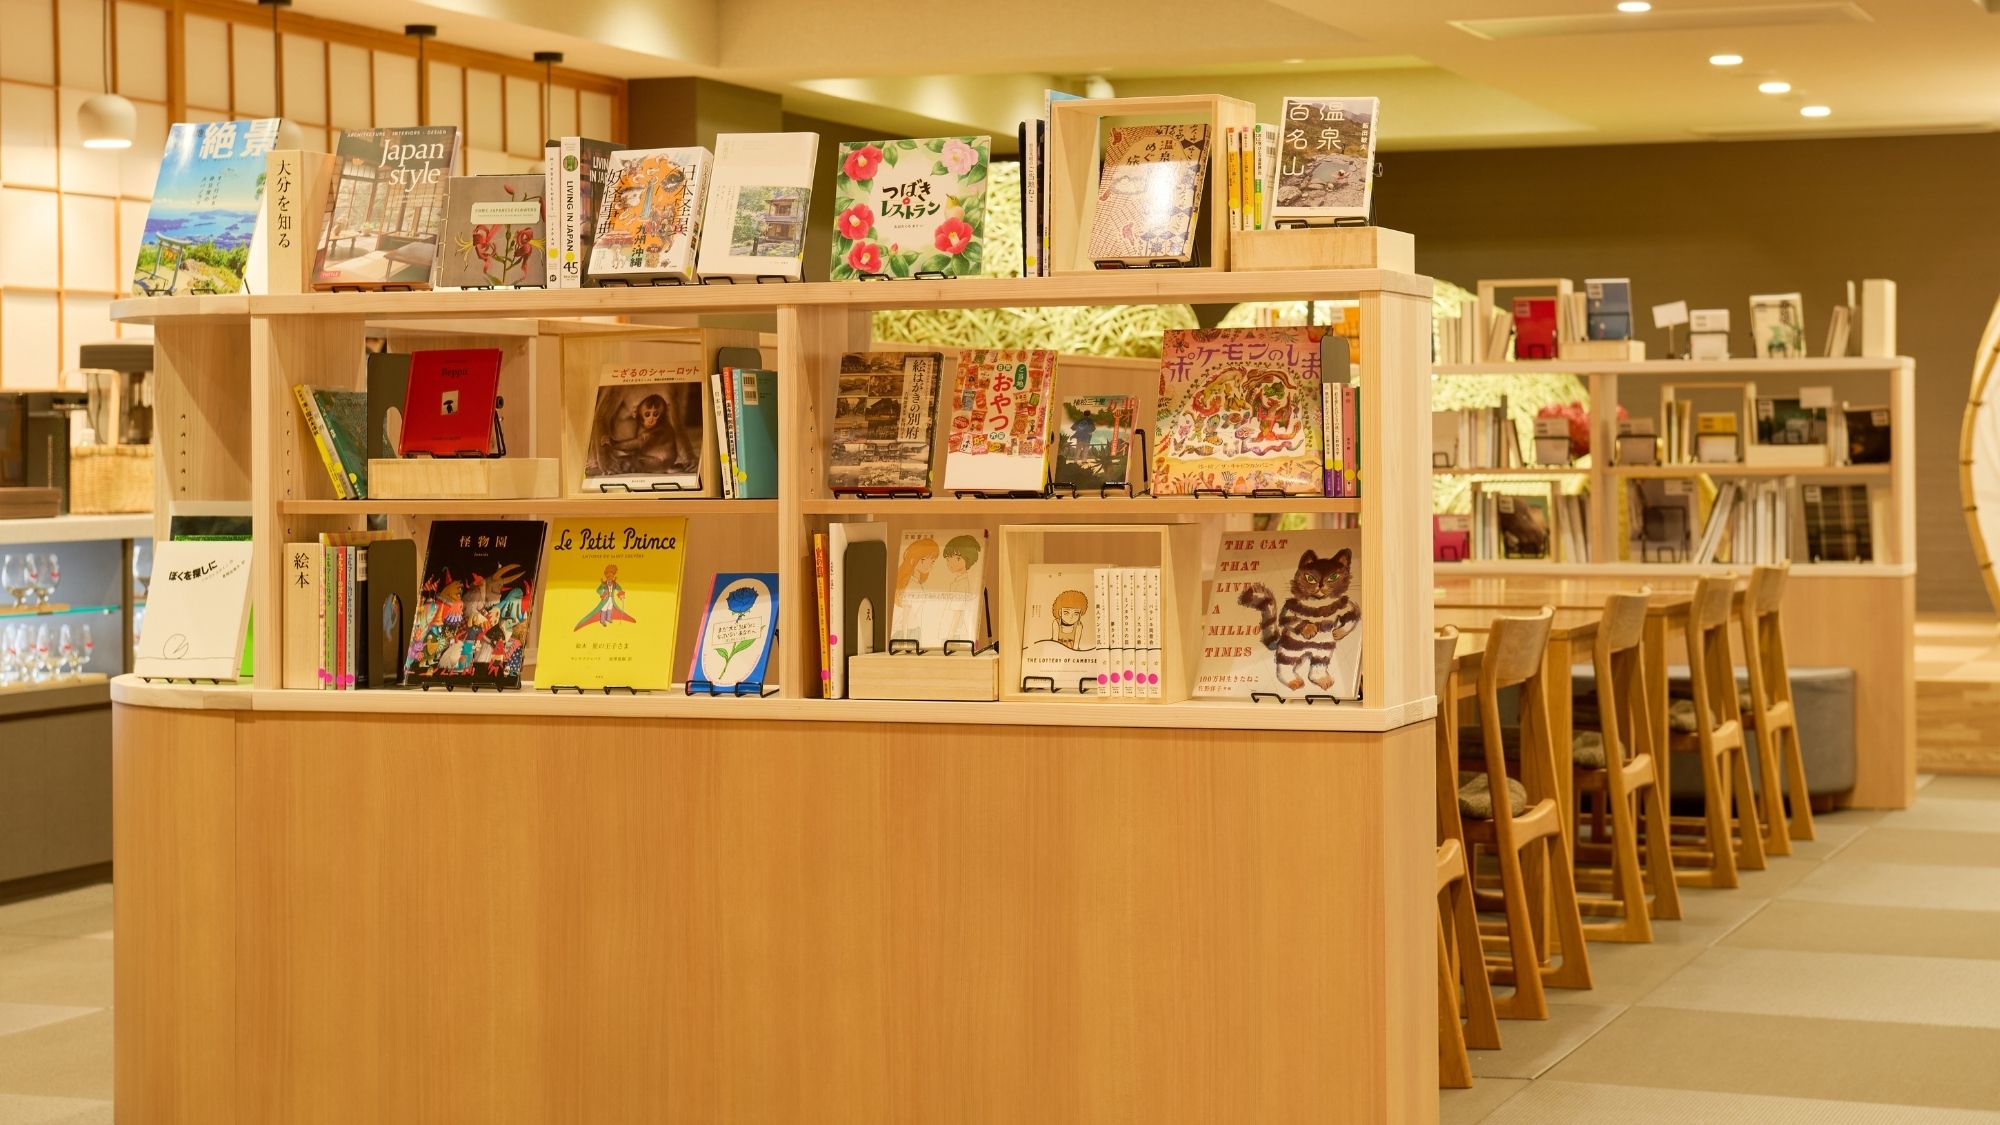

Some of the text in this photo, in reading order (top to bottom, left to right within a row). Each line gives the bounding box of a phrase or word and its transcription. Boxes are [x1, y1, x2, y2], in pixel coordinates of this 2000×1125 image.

[1316, 103, 1344, 150] 温泉
[199, 119, 277, 159] 絶景
[1283, 102, 1312, 176] 百名山
[379, 139, 444, 168] Japan
[593, 156, 610, 169] LIVIN
[388, 161, 441, 192] style
[882, 178, 931, 201] つばき
[277, 160, 291, 248] 大分を知る
[881, 200, 940, 219] レストラン
[566, 181, 574, 252] LIVING IN JAPAN
[630, 225, 647, 267] 九州・沖縄
[563, 262, 578, 275] 45
[611, 366, 699, 378] こざるのシャーロット
[1168, 343, 1320, 382] ポケモンのしま
[905, 360, 926, 439] 絵はがきの別府
[989, 373, 1013, 431] おやつ
[460, 536, 507, 547] 怪物園
[555, 527, 676, 550] Le Petit Prince
[1224, 539, 1288, 550] THE CAT
[168, 560, 218, 581] ぼくを探しに
[294, 552, 309, 588] 絵本
[1220, 560, 1260, 571] THAT
[1216, 582, 1252, 593] LIVE
[1212, 604, 1220, 614] A
[1208, 625, 1261, 636] MILLIO
[1205, 646, 1252, 657] TIMES
[1199, 675, 1259, 683] 100万回生きたねこ
